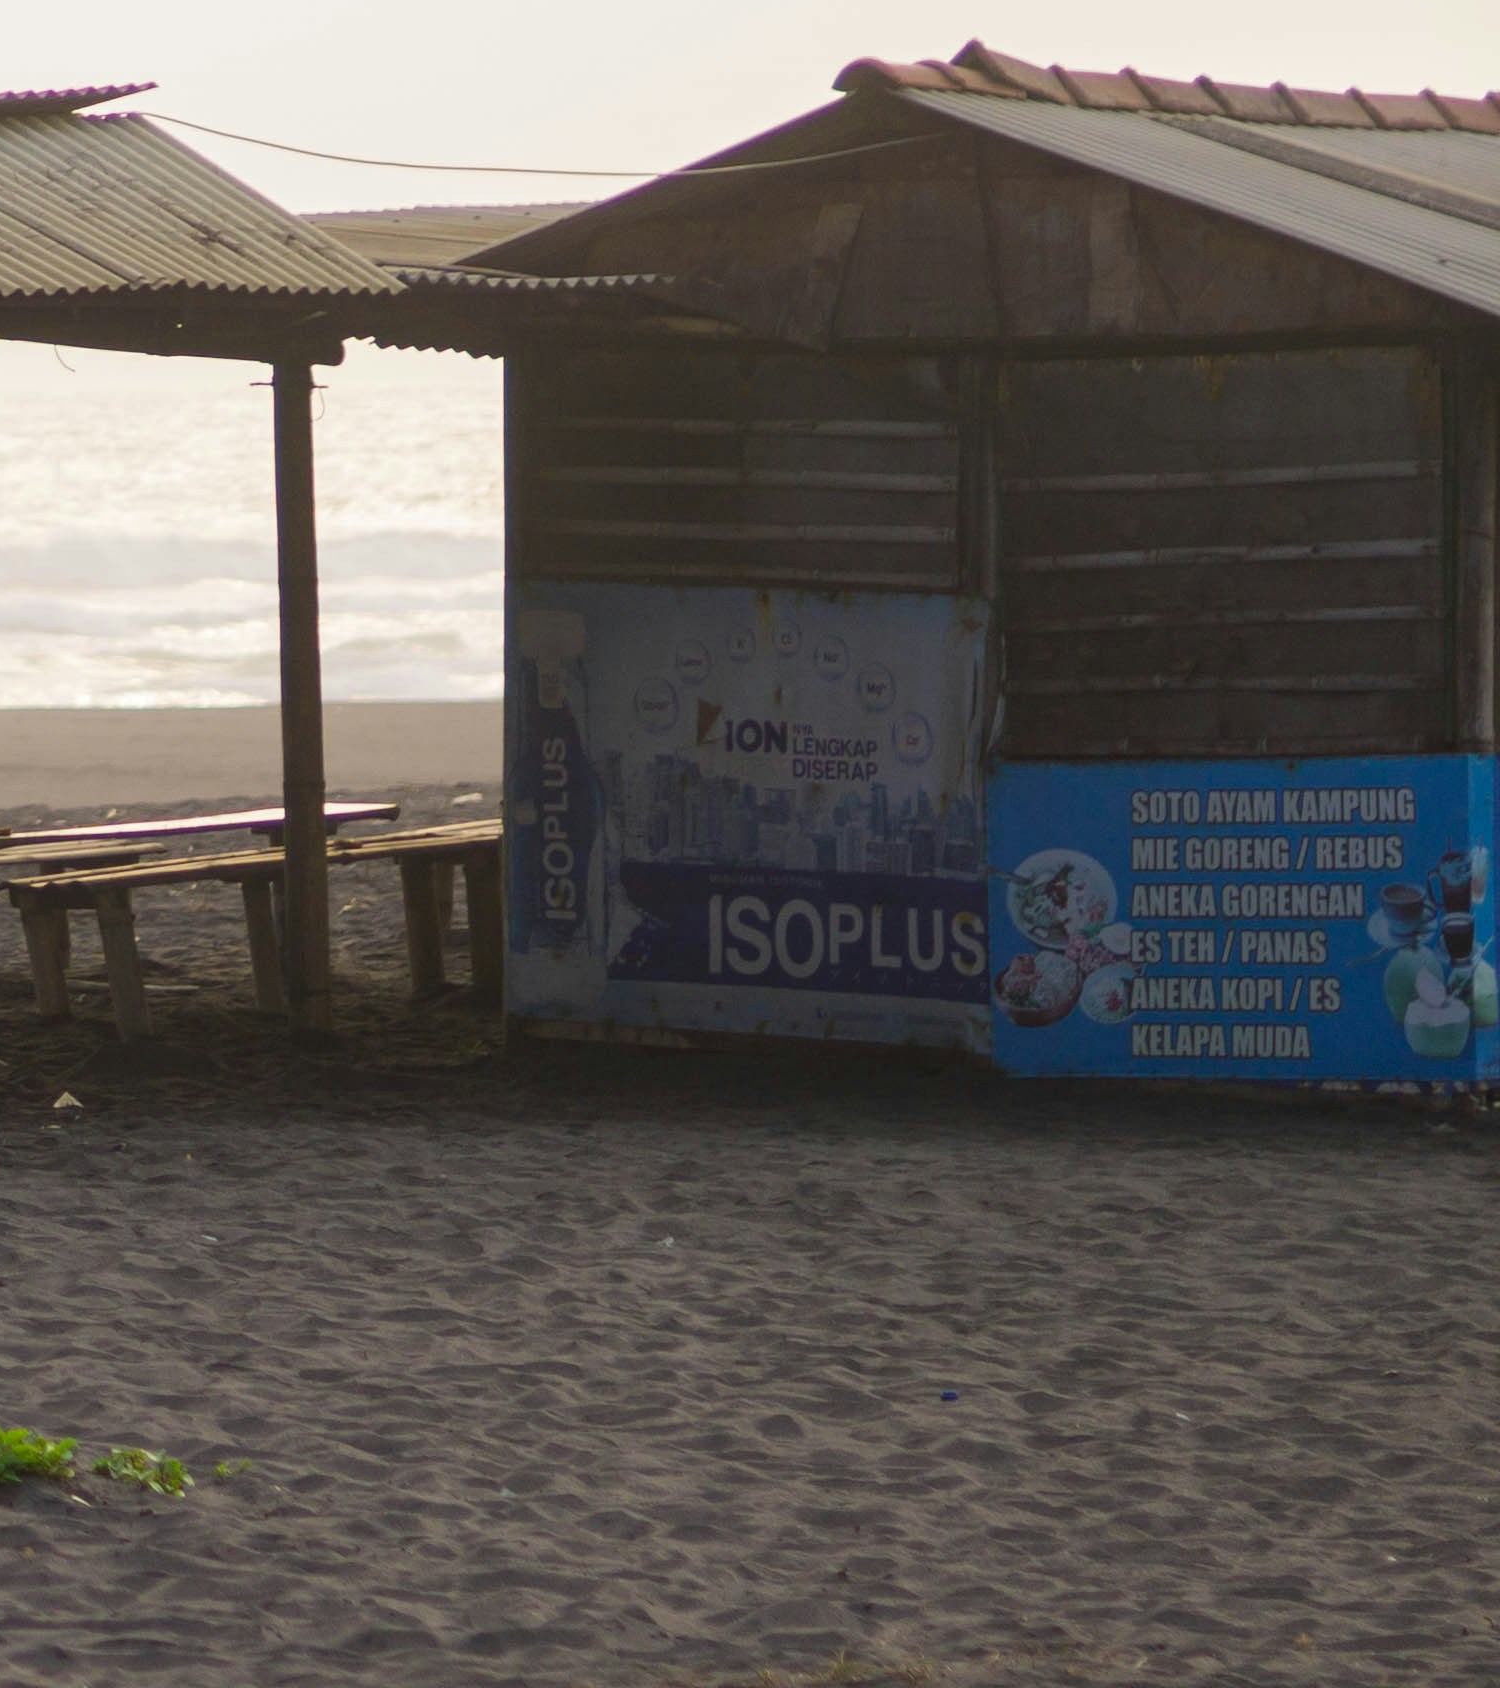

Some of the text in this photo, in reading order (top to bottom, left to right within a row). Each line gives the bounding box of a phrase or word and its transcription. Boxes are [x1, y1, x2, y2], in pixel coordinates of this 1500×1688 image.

[724, 720, 788, 755] ION
[792, 738, 878, 759] LENGKAP
[792, 759, 878, 783] DISERAP
[1131, 788, 1416, 824] SOTO AYAM KAMPUNG
[542, 736, 577, 922] ISOPLUS
[1131, 836, 1403, 871] MIE GORENG / REBUS
[1131, 883, 1365, 918] ANEKA GORENGAN
[708, 893, 987, 979] ISOPLUS
[1131, 931, 1328, 964] ES TEH / PANAS
[1130, 978, 1342, 1011] ANEKA KOPI / ES
[1131, 1025, 1311, 1058] KELAPA MUDA
